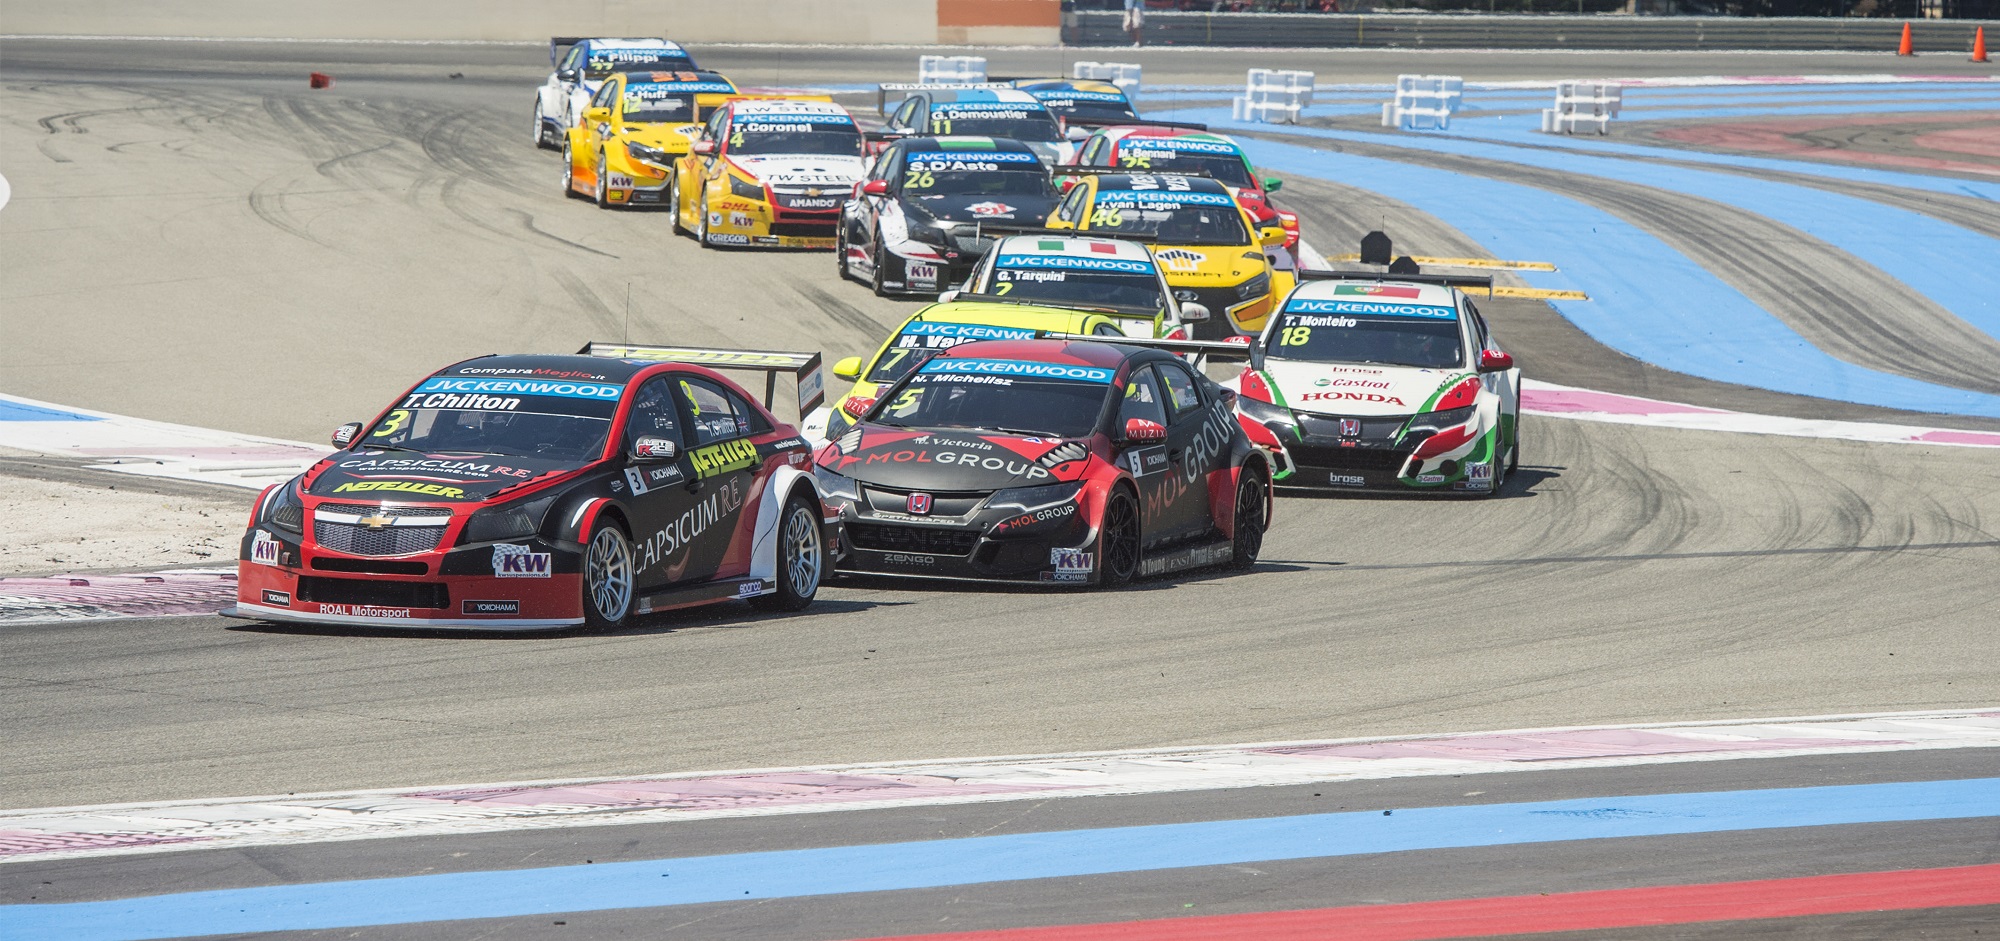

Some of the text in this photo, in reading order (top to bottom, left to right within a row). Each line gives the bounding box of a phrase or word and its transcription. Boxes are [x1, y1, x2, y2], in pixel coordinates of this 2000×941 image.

[608, 54, 659, 63] Filippi
[623, 97, 642, 115] 12
[950, 110, 1028, 120] Demoustier
[931, 120, 952, 135] 11
[729, 131, 745, 148] 4
[1133, 149, 1177, 159] Bennani
[611, 176, 634, 187] KW
[903, 171, 936, 189] 26
[720, 202, 752, 212] DHL
[1138, 201, 1182, 211] Lagen
[733, 216, 755, 227] KW
[1089, 208, 1123, 227] 46
[910, 266, 936, 277] KW
[997, 271, 1066, 284] G. Tarquini
[1284, 315, 1358, 328] T. Monteiro
[899, 335, 921, 349] H.
[1279, 327, 1312, 347] 18
[881, 350, 910, 371] 7
[1332, 366, 1384, 375] brose
[910, 373, 1015, 387] N. Michelisz
[1332, 378, 1391, 391] Castrol
[679, 380, 700, 416] 3
[890, 388, 927, 411] 5
[1300, 392, 1407, 407] HONDA
[372, 409, 410, 438] 3
[1128, 429, 1166, 438] MUZIX
[931, 437, 994, 451] Victoria
[339, 459, 532, 479] CAPSICUM RE
[1132, 455, 1139, 473] 5
[358, 466, 489, 479] www.capsicumRE.com
[630, 471, 642, 492] 3
[649, 465, 679, 482] YOKOHAMA
[1329, 472, 1365, 485] brose
[1471, 466, 1492, 478] KW
[332, 481, 465, 499] NETELLER
[632, 475, 742, 576] CAPSICUM RE
[255, 540, 278, 561] KW
[502, 554, 550, 573] KW
[1058, 553, 1093, 569] KW
[1053, 573, 1088, 581] YOKOHAMA
[739, 581, 762, 594] sparco
[319, 604, 411, 619] ROAL Motorsport
[476, 603, 517, 612] YOKOHAMA
